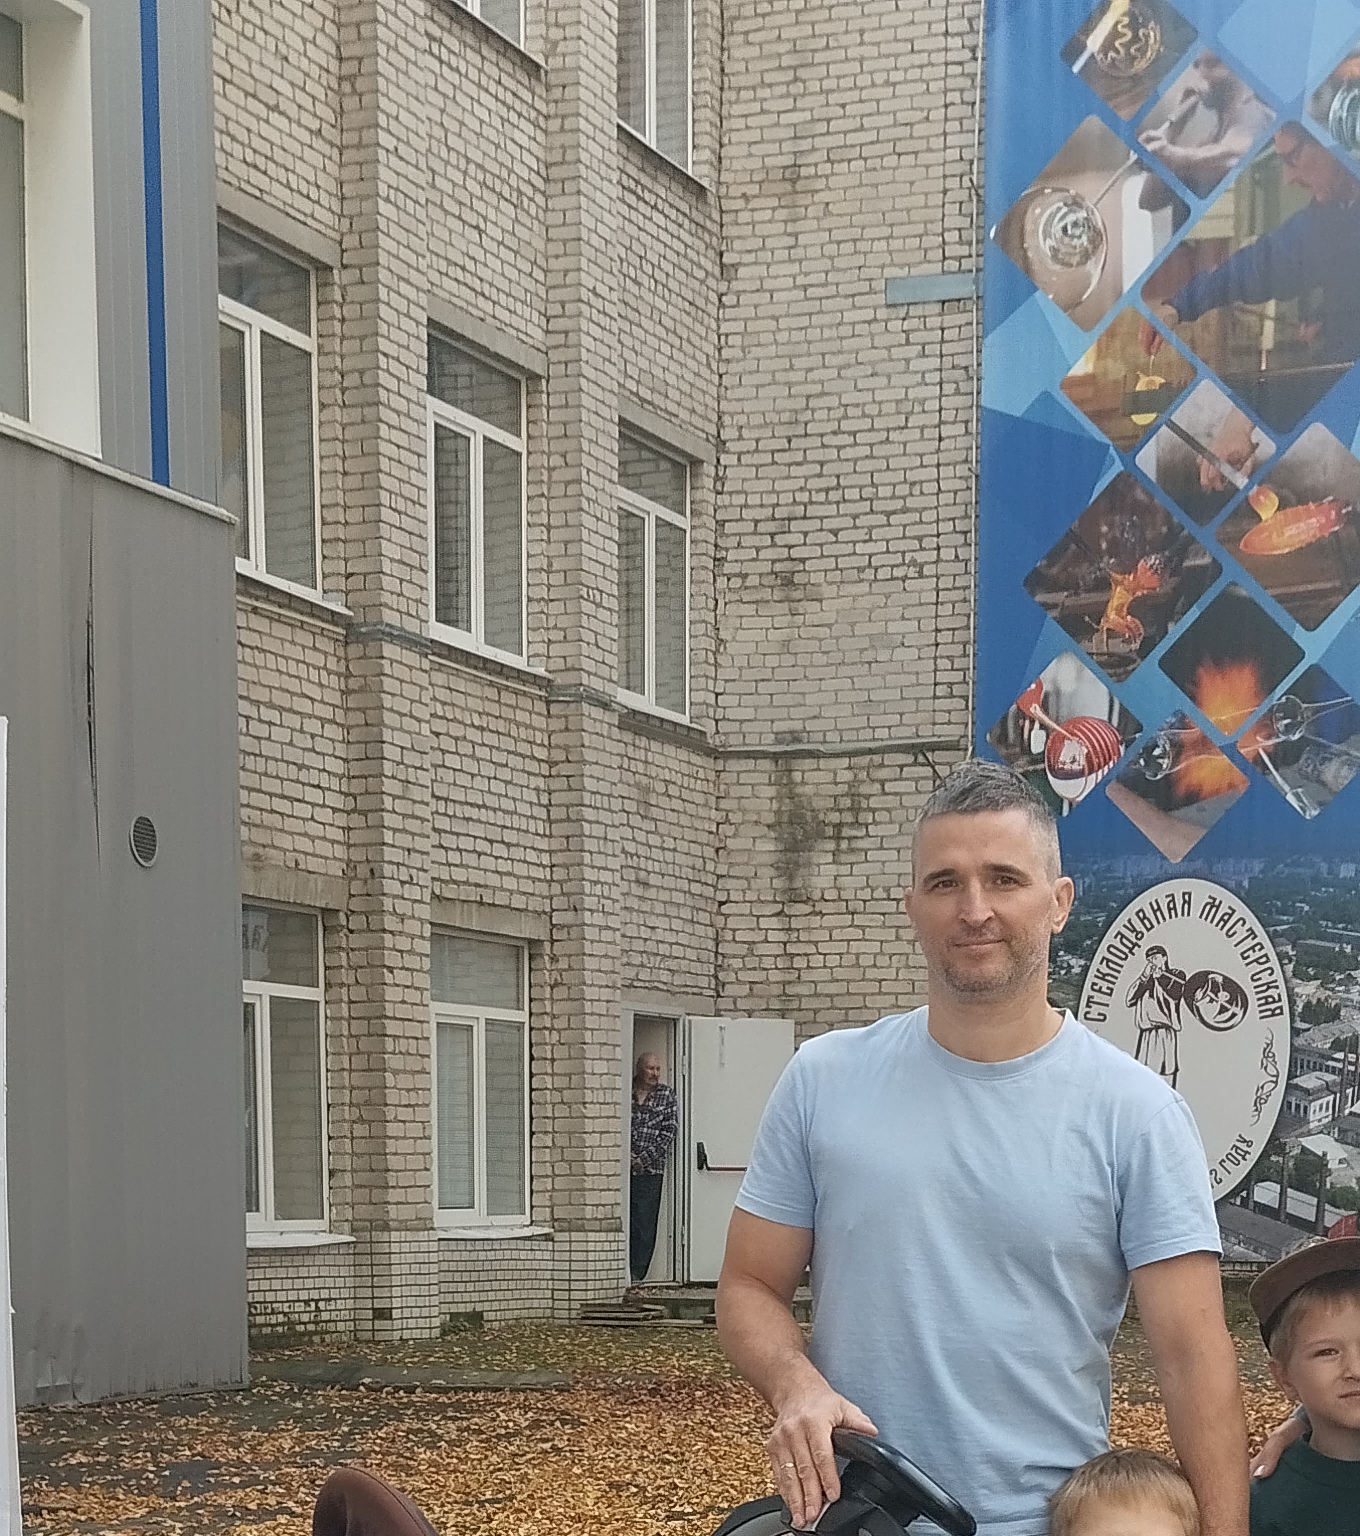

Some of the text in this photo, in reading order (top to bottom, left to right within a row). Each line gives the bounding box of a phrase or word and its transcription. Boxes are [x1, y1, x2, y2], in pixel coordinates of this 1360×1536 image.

[1083, 890, 1284, 1023] СТЕКЛОДУВНАЯ МАСТЕРСКАЯ
[1218, 1133, 1254, 1176] ГОДУ
